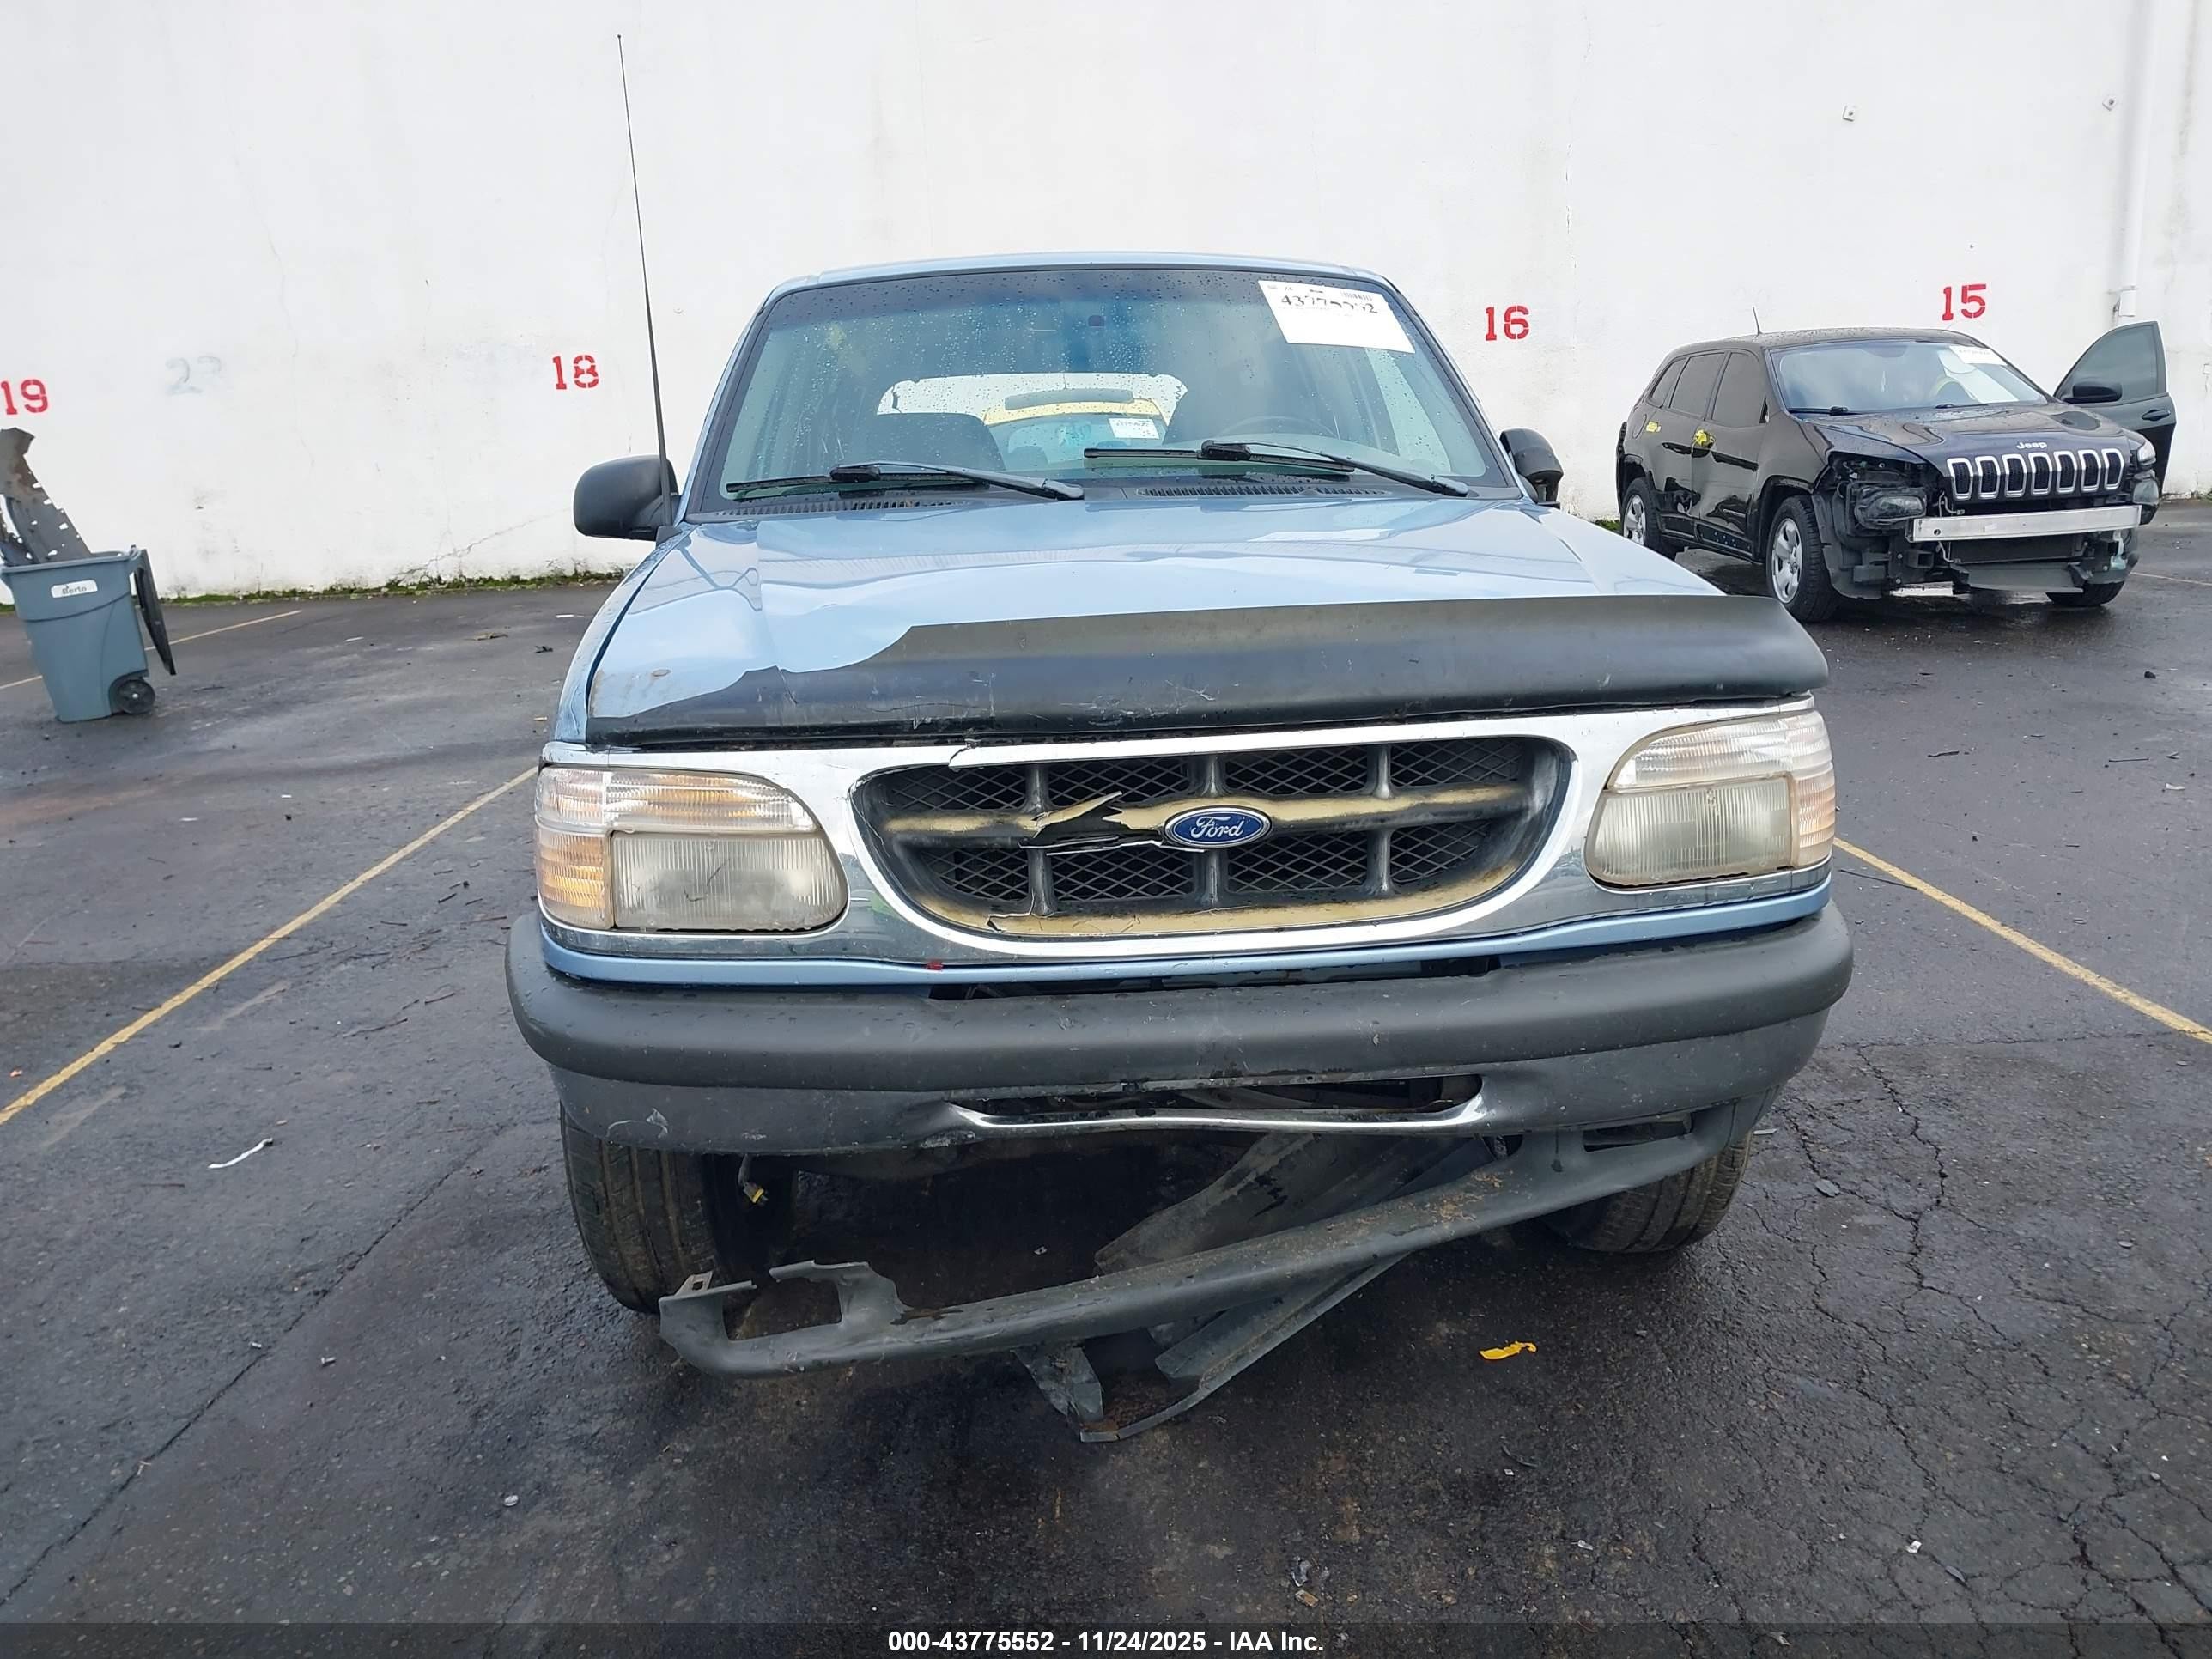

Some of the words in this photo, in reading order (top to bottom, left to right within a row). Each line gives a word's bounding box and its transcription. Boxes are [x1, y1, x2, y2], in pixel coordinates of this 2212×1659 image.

[1942, 283, 1986, 322] 15
[1485, 305, 1529, 342] 16
[552, 354, 599, 391] 18
[0, 379, 49, 416] 19
[1190, 816, 1245, 838] Ford
